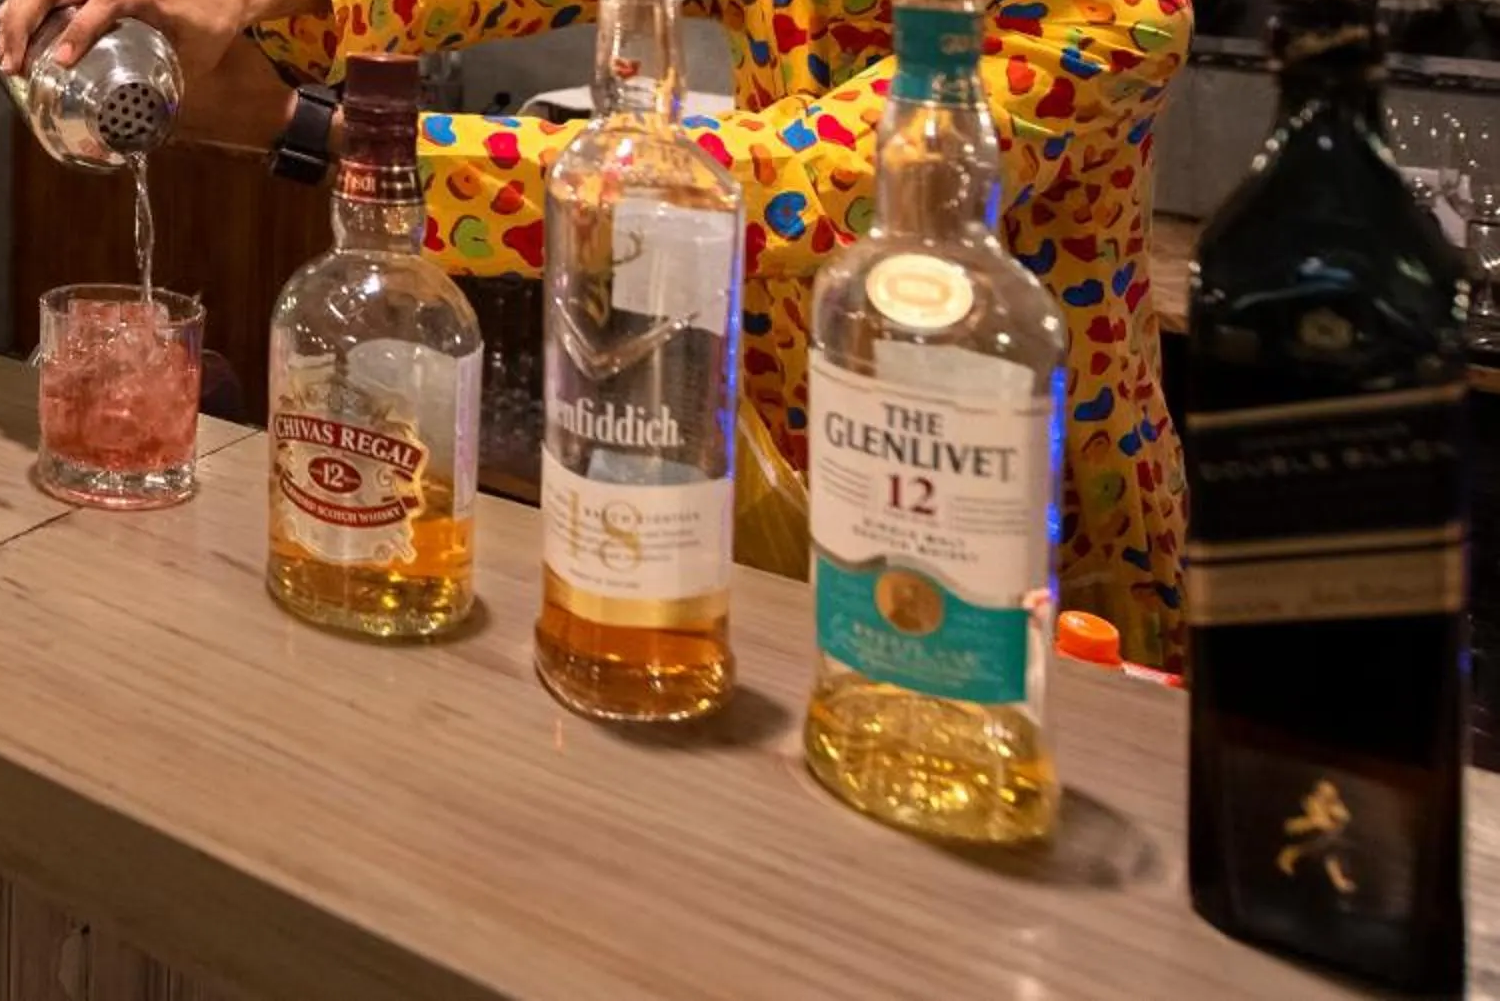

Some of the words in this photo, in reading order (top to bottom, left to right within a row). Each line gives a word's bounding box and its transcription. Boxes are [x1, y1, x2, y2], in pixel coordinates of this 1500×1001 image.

[882, 401, 944, 437] THE
[274, 416, 334, 445] CHIVAS
[340, 426, 416, 470] REGAL
[824, 411, 1018, 483] GLENLIVET
[322, 461, 346, 488] 12
[888, 473, 937, 516] 12
